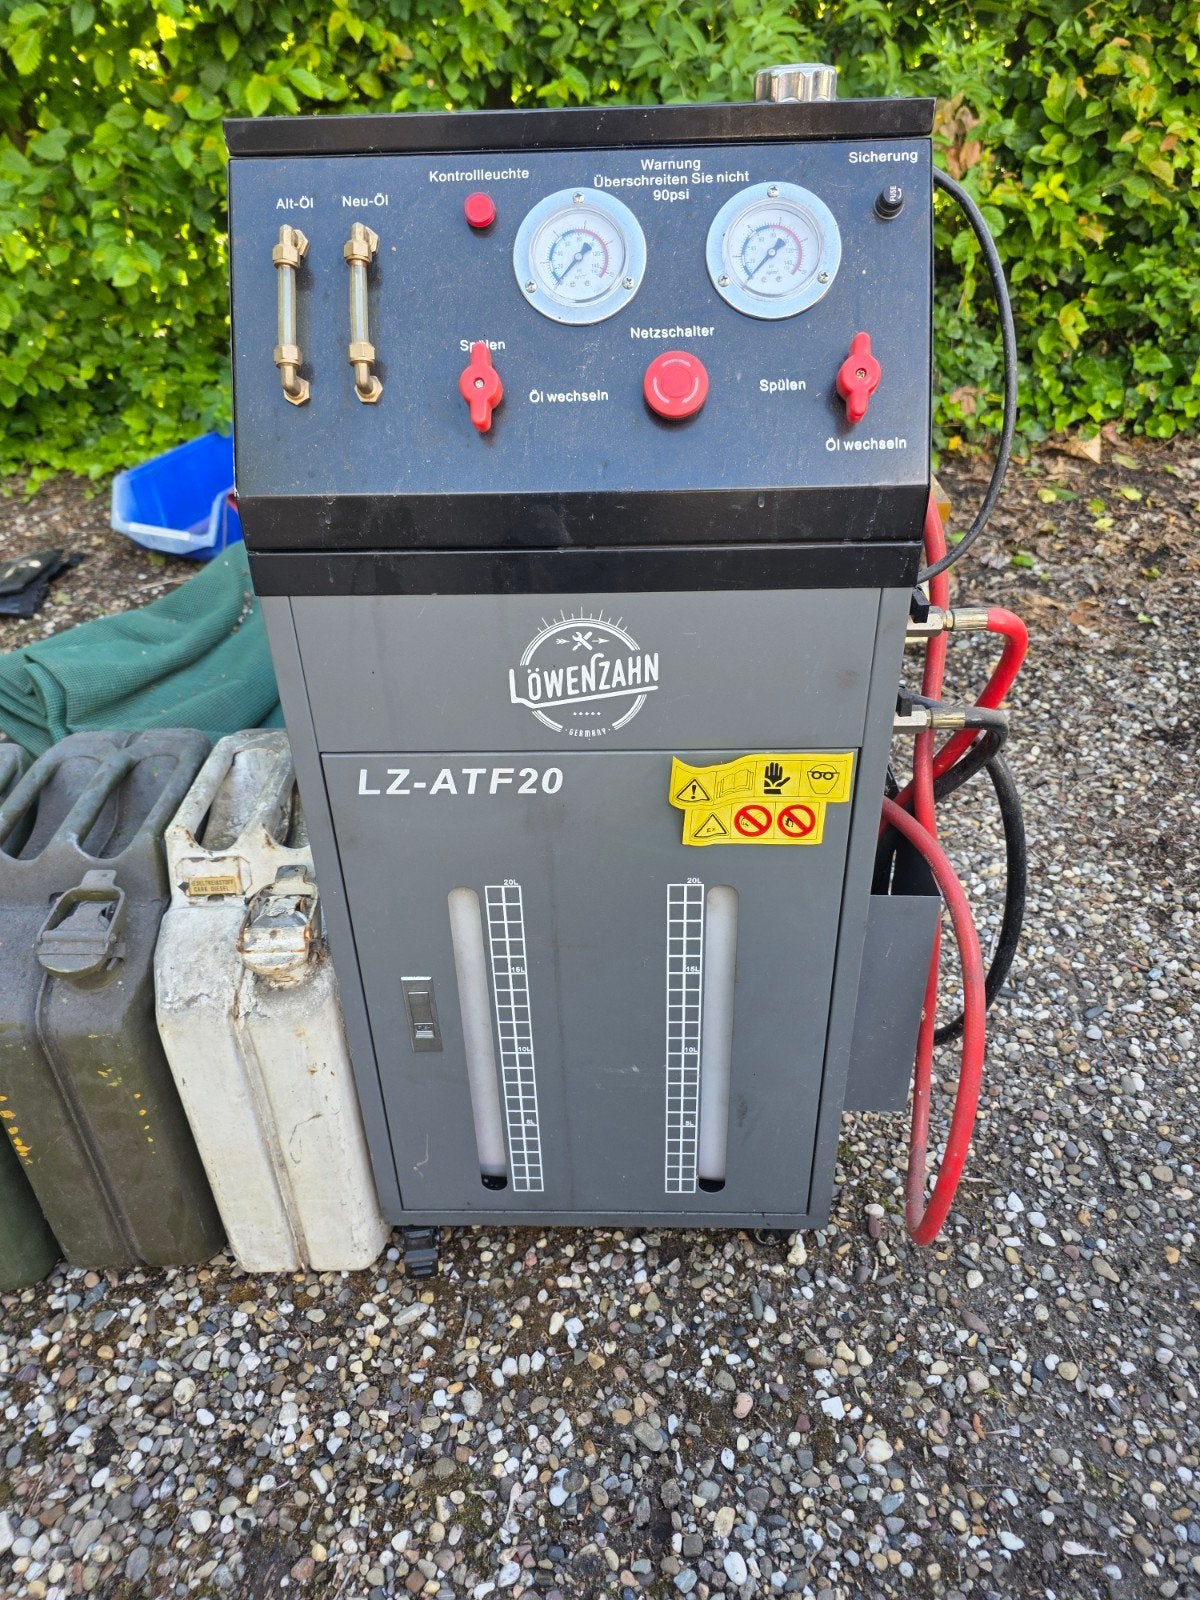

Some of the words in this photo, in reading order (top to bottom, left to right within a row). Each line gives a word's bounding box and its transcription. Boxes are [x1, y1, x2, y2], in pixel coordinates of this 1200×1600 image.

[848, 150, 919, 164] Sicherung
[640, 158, 702, 174] Warnung
[429, 167, 530, 183] Kontrollleuchte
[593, 173, 688, 188] Überschreiten
[691, 172, 714, 184] Sie
[716, 170, 750, 184] nicht
[342, 192, 389, 207] Neu-Öl
[652, 188, 690, 203] 90psi
[889, 185, 897, 202] FUSE
[276, 195, 314, 210] Alt-Öl
[630, 325, 715, 339] Netzschalter
[459, 339, 506, 353] Slen
[759, 378, 806, 394] Spülen
[529, 389, 544, 403] Öl
[546, 389, 609, 404] wechseln
[825, 437, 840, 452] Öl
[843, 436, 907, 451] wechseln
[508, 653, 660, 706] LÖWENZAHN
[568, 727, 607, 738] GERMANY
[358, 767, 564, 797] LZ-ATF20
